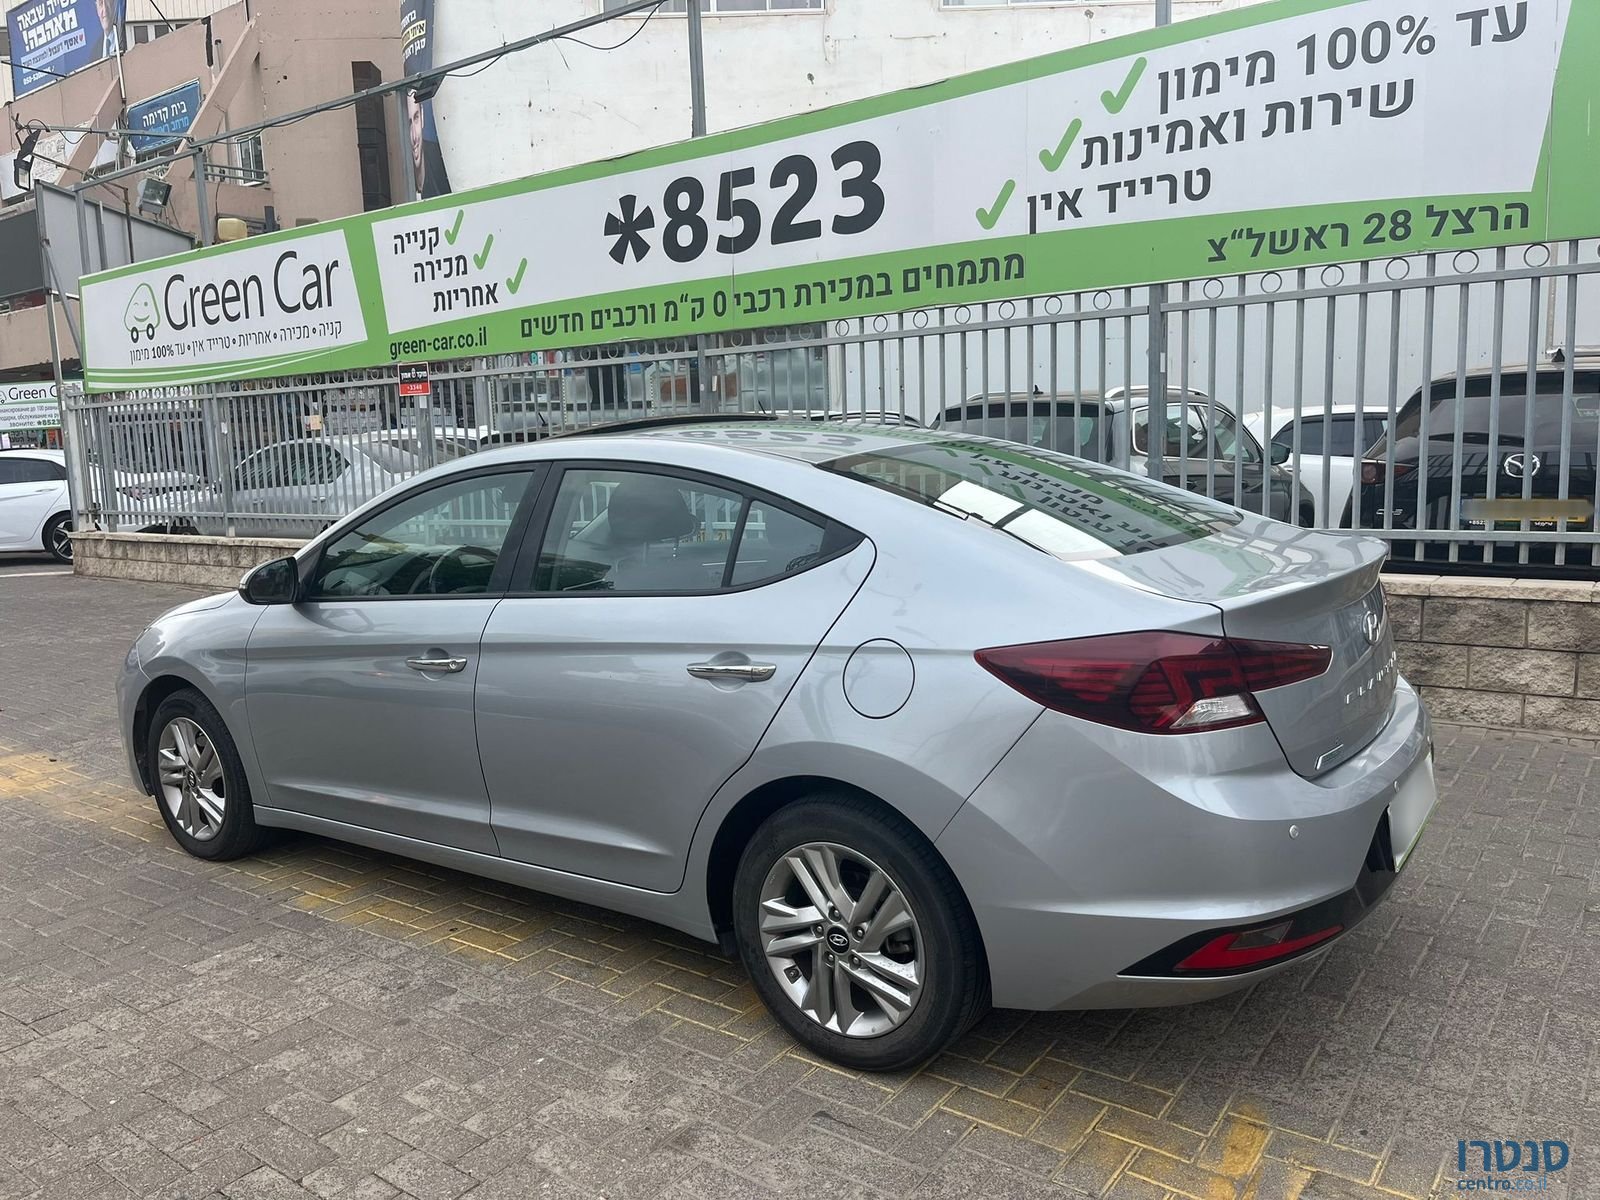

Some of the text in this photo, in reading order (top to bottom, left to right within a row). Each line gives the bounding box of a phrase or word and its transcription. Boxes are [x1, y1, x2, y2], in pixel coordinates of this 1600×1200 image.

[17, 3, 45, 31] שבאה
[22, 7, 78, 52] מאהבה!
[1158, 1, 1528, 116] עד 100% מימון
[142, 101, 187, 128] בית קדימה
[1080, 78, 1415, 170] שירות ואמינות
[1027, 167, 1211, 235] טרייד אין
[1363, 209, 1412, 245] 28
[1425, 202, 1529, 237] הרצל
[393, 226, 440, 255] קנייה
[413, 254, 468, 283] מכירה
[903, 253, 1025, 293] מתמחים
[164, 251, 339, 331] Green Car
[433, 282, 499, 313] אחריות
[713, 290, 728, 318] 0
[733, 287, 786, 314] רכבי
[793, 272, 893, 307] במכירת
[521, 311, 584, 338] חדשים
[591, 303, 656, 330] ורכבים
[129, 320, 342, 366] קניה מכירה אחריות טרייד אין עד 100% מימון
[390, 326, 487, 361] green-car.co.il
[8, 387, 47, 401] Green
